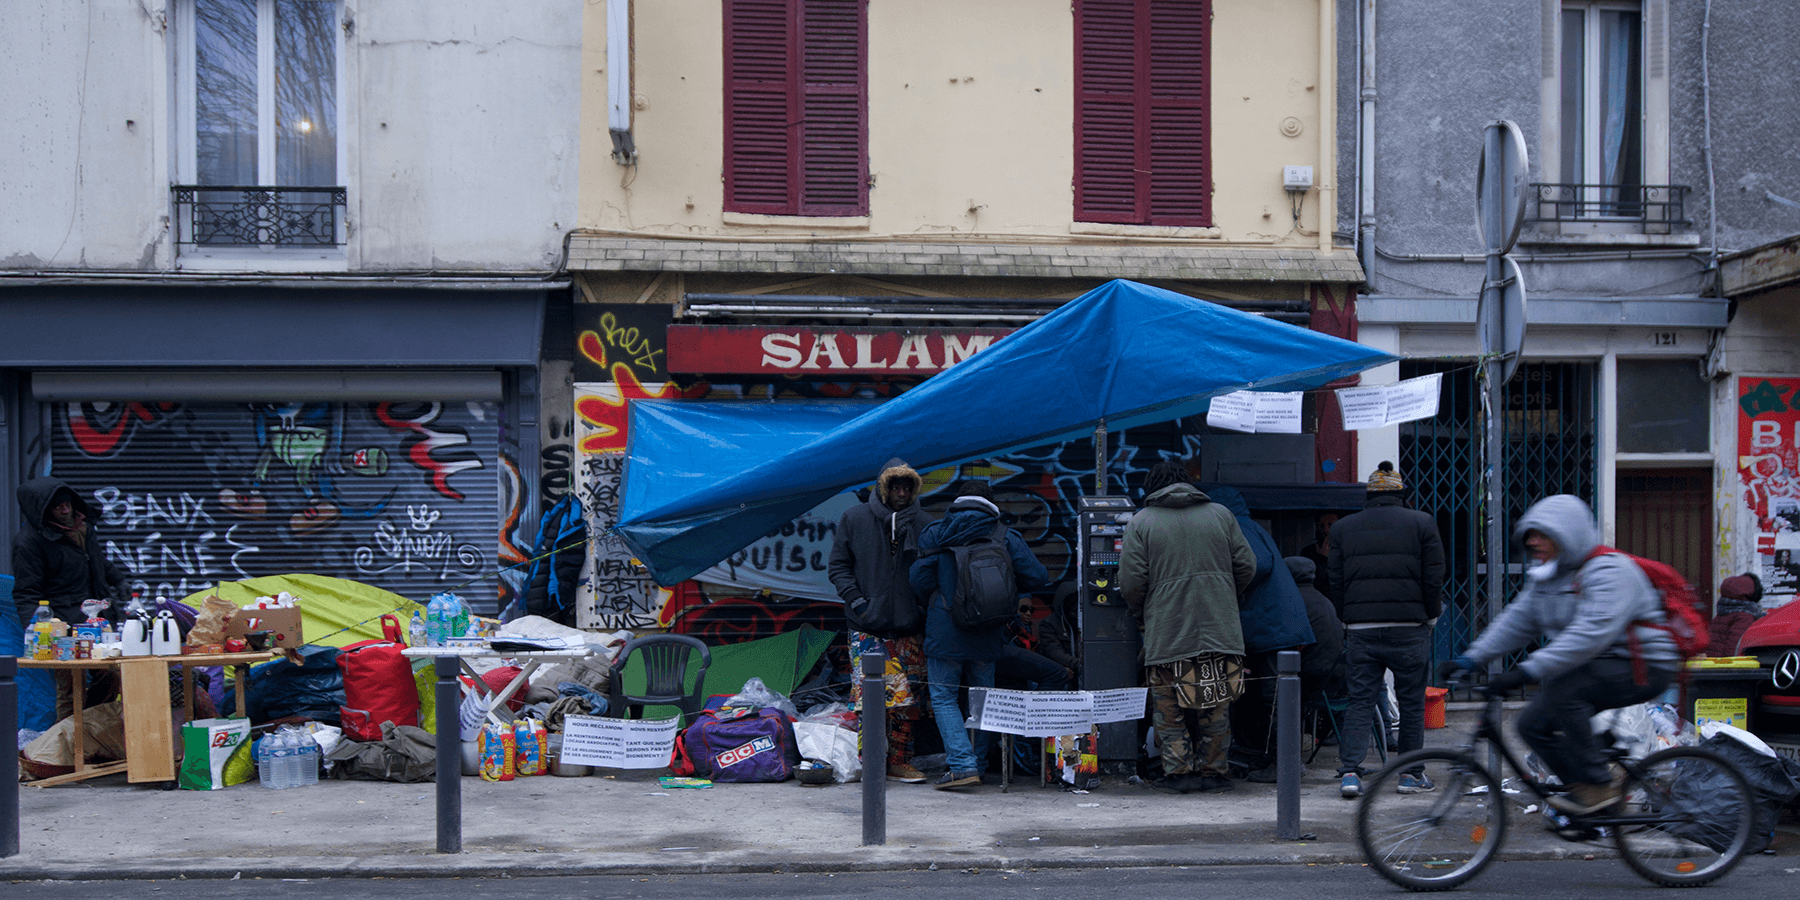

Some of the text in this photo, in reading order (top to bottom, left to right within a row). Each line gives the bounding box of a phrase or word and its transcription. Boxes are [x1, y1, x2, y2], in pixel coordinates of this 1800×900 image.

[761, 332, 1002, 369] SALAM
[1655, 332, 1677, 345] 121
[1752, 420, 1800, 448] B
[93, 486, 216, 531] BEAUX
[720, 737, 774, 765] CCM
